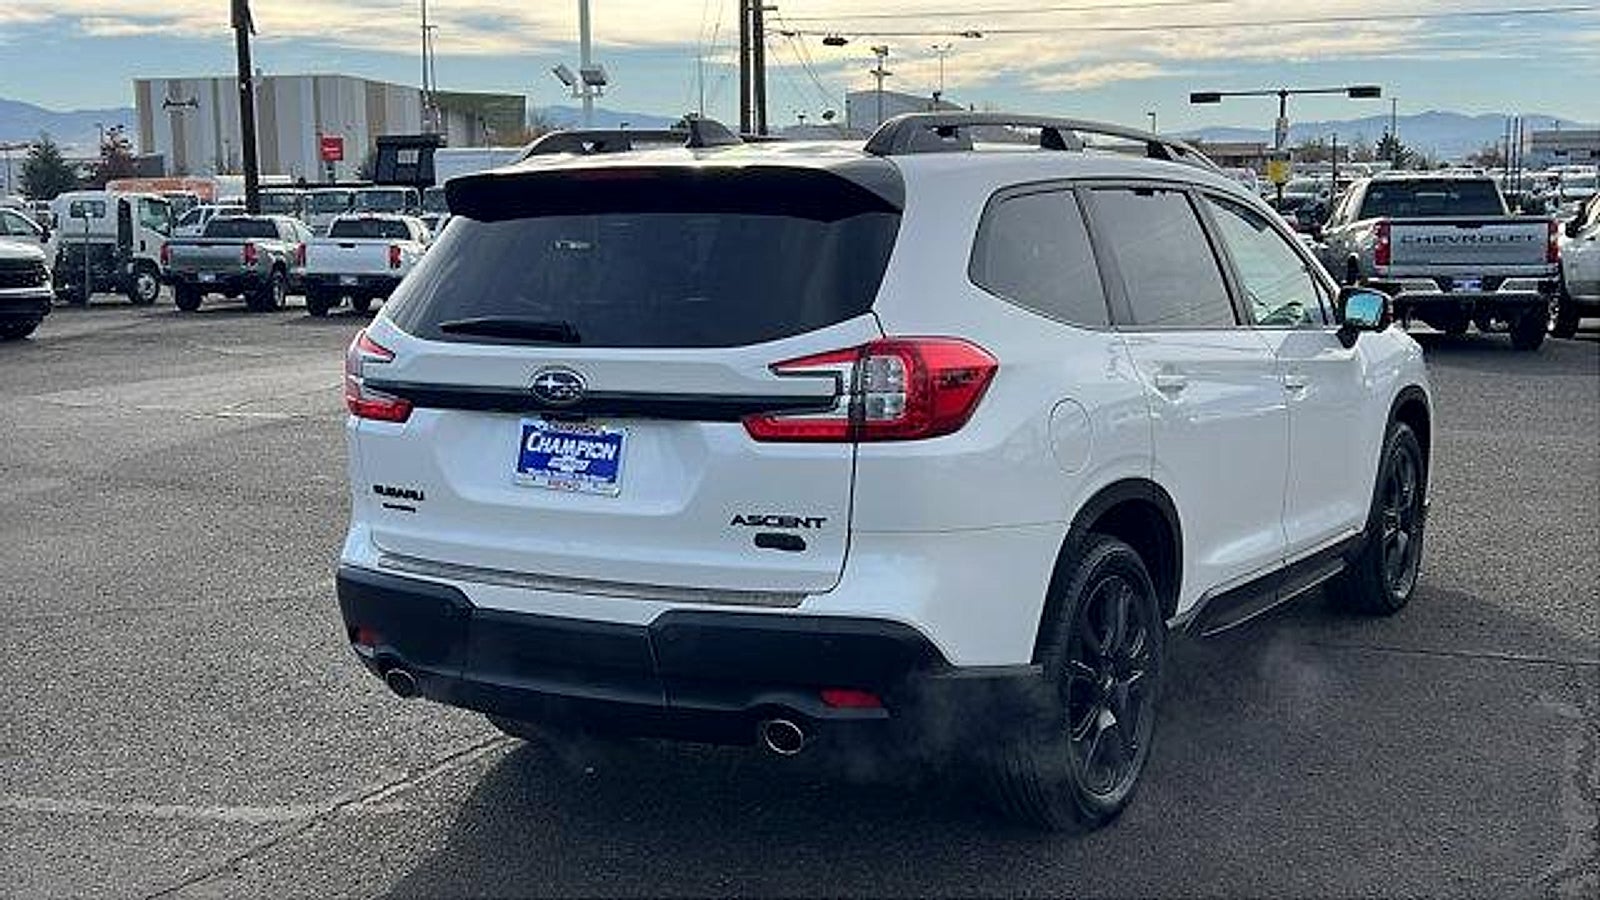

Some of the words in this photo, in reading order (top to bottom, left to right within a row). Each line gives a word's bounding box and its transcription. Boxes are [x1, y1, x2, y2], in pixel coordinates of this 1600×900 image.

[1402, 233, 1536, 244] CHEVROLET
[527, 432, 618, 460] CHAMPION
[730, 514, 828, 529] ASCENT
